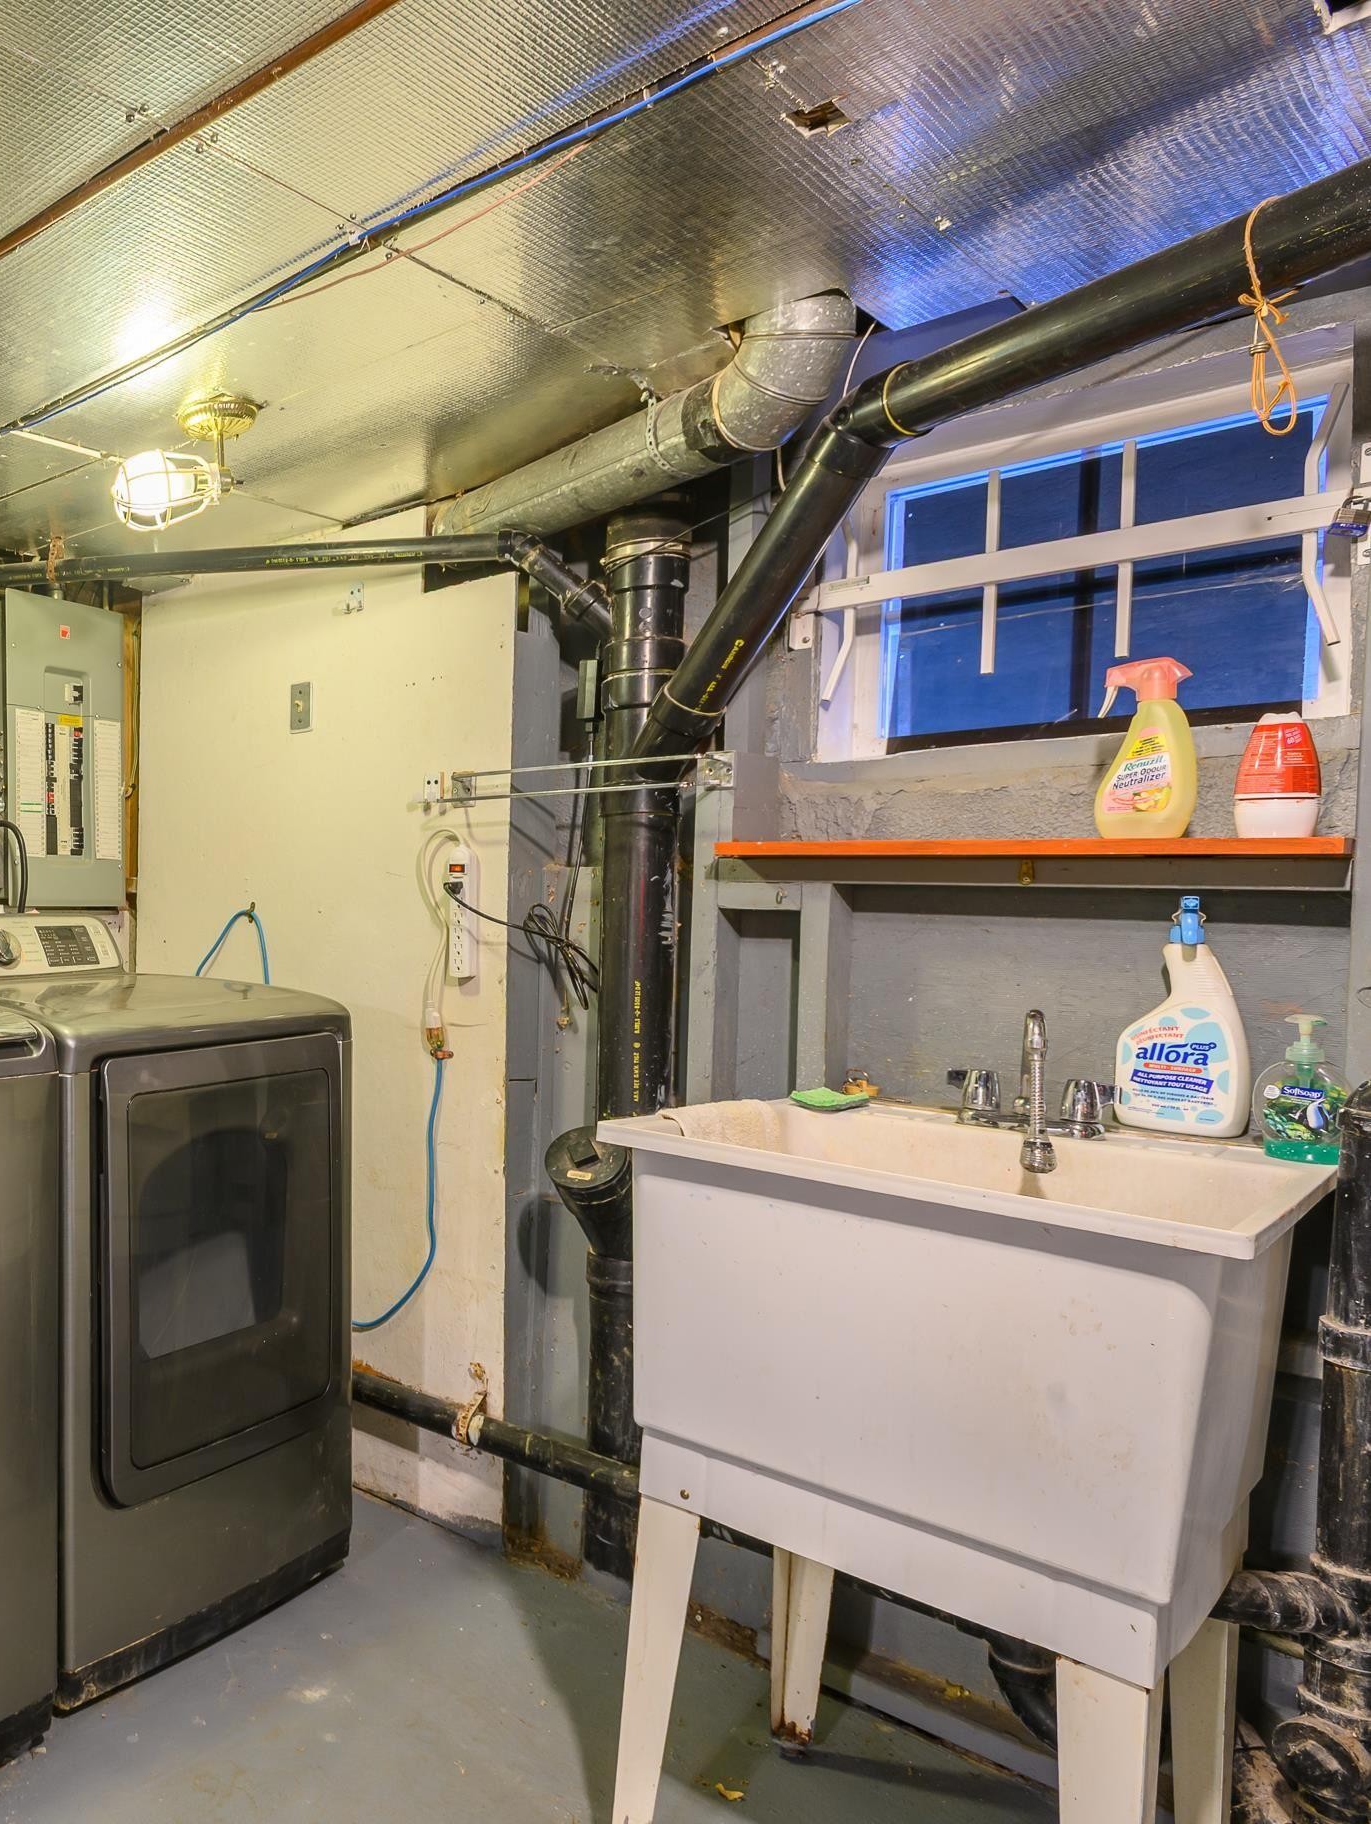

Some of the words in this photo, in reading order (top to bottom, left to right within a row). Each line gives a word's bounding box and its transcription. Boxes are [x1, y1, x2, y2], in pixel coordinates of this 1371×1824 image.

[1124, 755, 1163, 772] Renuzit
[1113, 772, 1166, 790] Neutralizer
[1133, 1077, 1167, 1086] NETTOYANT
[1186, 1084, 1208, 1093] USAGE
[1149, 1073, 1177, 1081] PURPOSE
[1177, 1076, 1207, 1085] CLEANER
[1283, 1086, 1321, 1098] Softsoap
